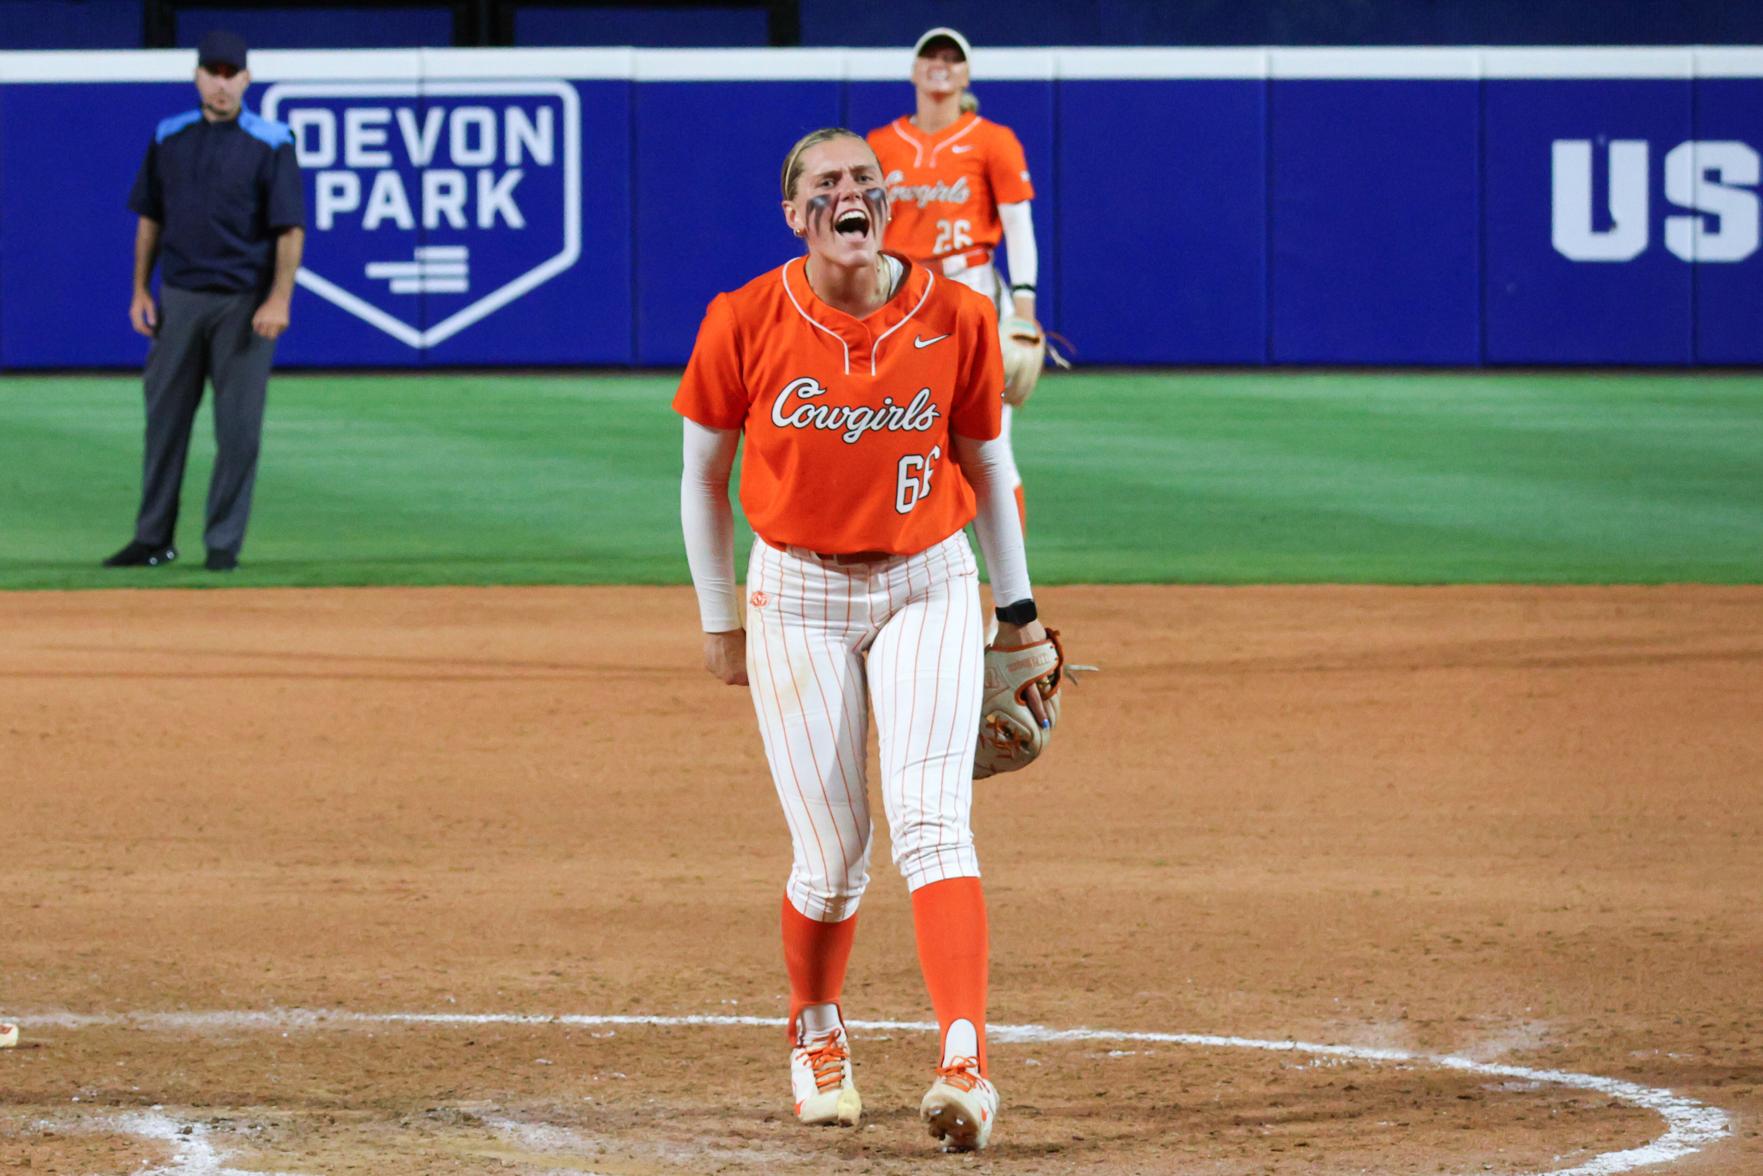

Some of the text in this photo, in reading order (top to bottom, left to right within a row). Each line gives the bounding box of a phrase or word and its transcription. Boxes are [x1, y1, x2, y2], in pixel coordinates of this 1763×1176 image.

[288, 106, 555, 168] DEVON
[315, 168, 526, 231] PARK
[1551, 139, 1760, 264] US
[932, 218, 974, 255] 26
[771, 376, 942, 444] Cowgirls
